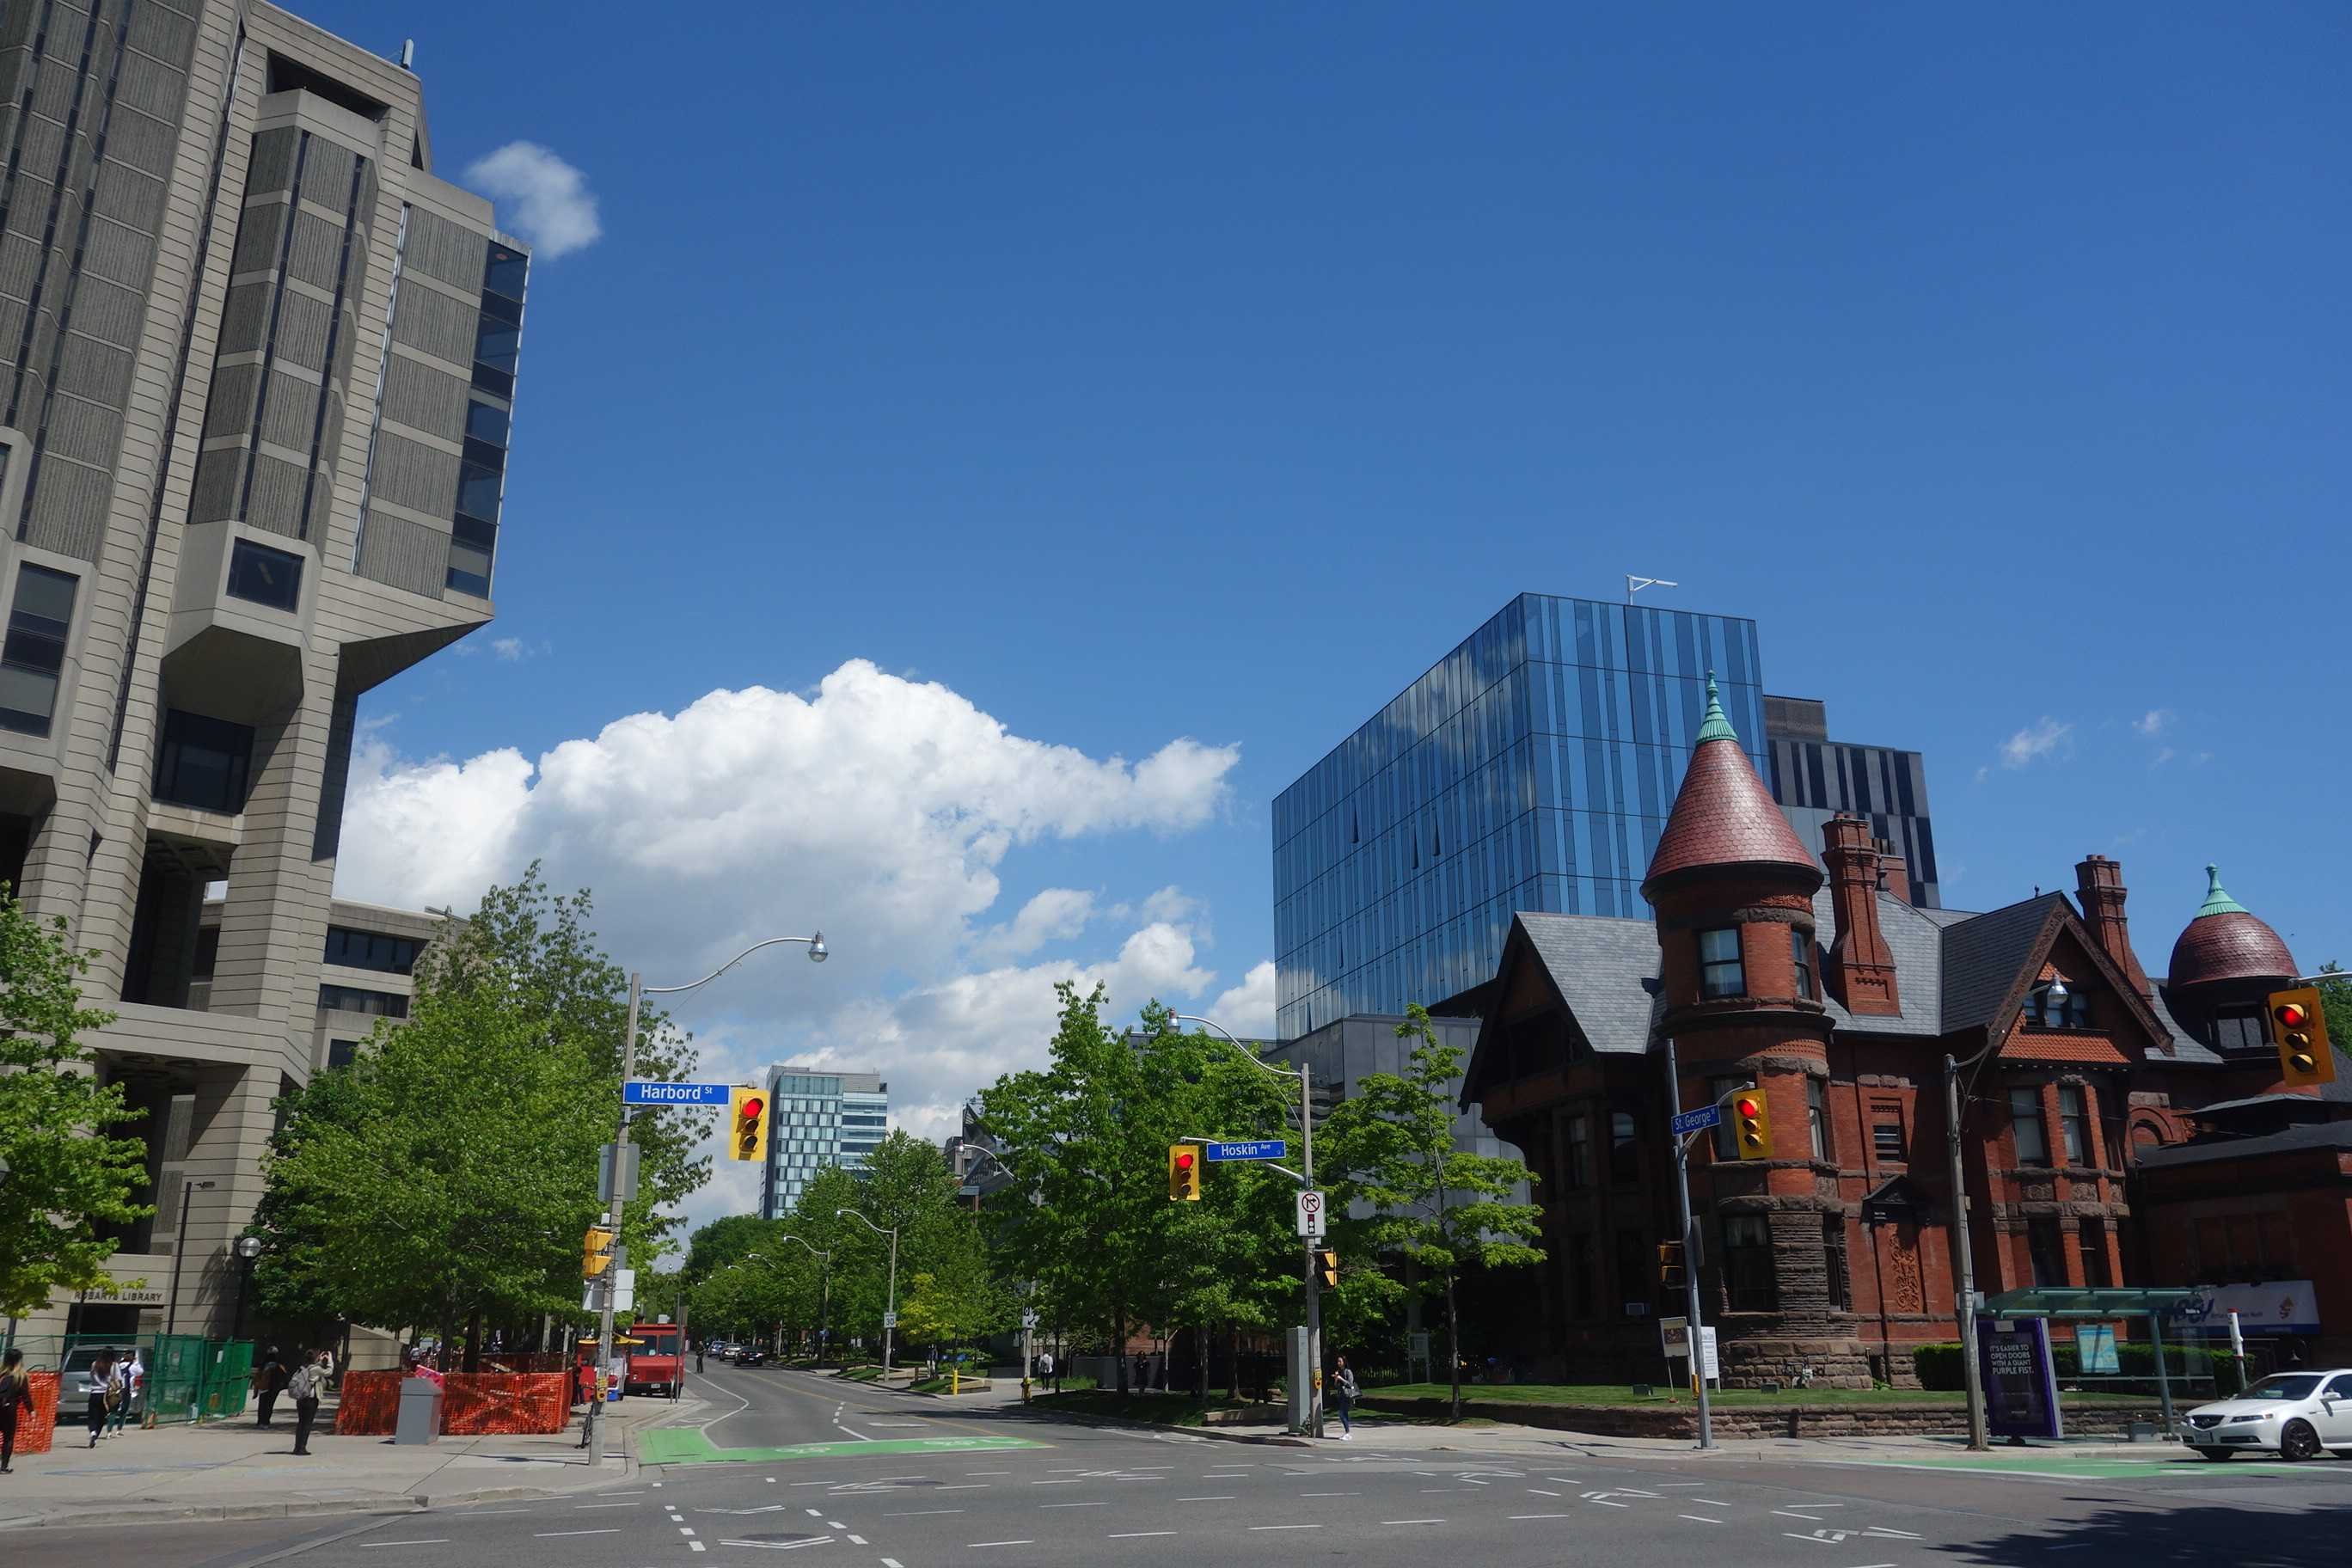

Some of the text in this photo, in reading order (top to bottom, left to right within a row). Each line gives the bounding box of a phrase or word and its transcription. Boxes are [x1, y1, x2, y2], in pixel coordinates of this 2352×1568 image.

[640, 1084, 713, 1099] Harbord St
[1675, 1118, 1684, 1130] St.
[1685, 1112, 1712, 1128] George
[1221, 1143, 1258, 1156] Hoskin
[122, 1291, 162, 1302] LIBRARY
